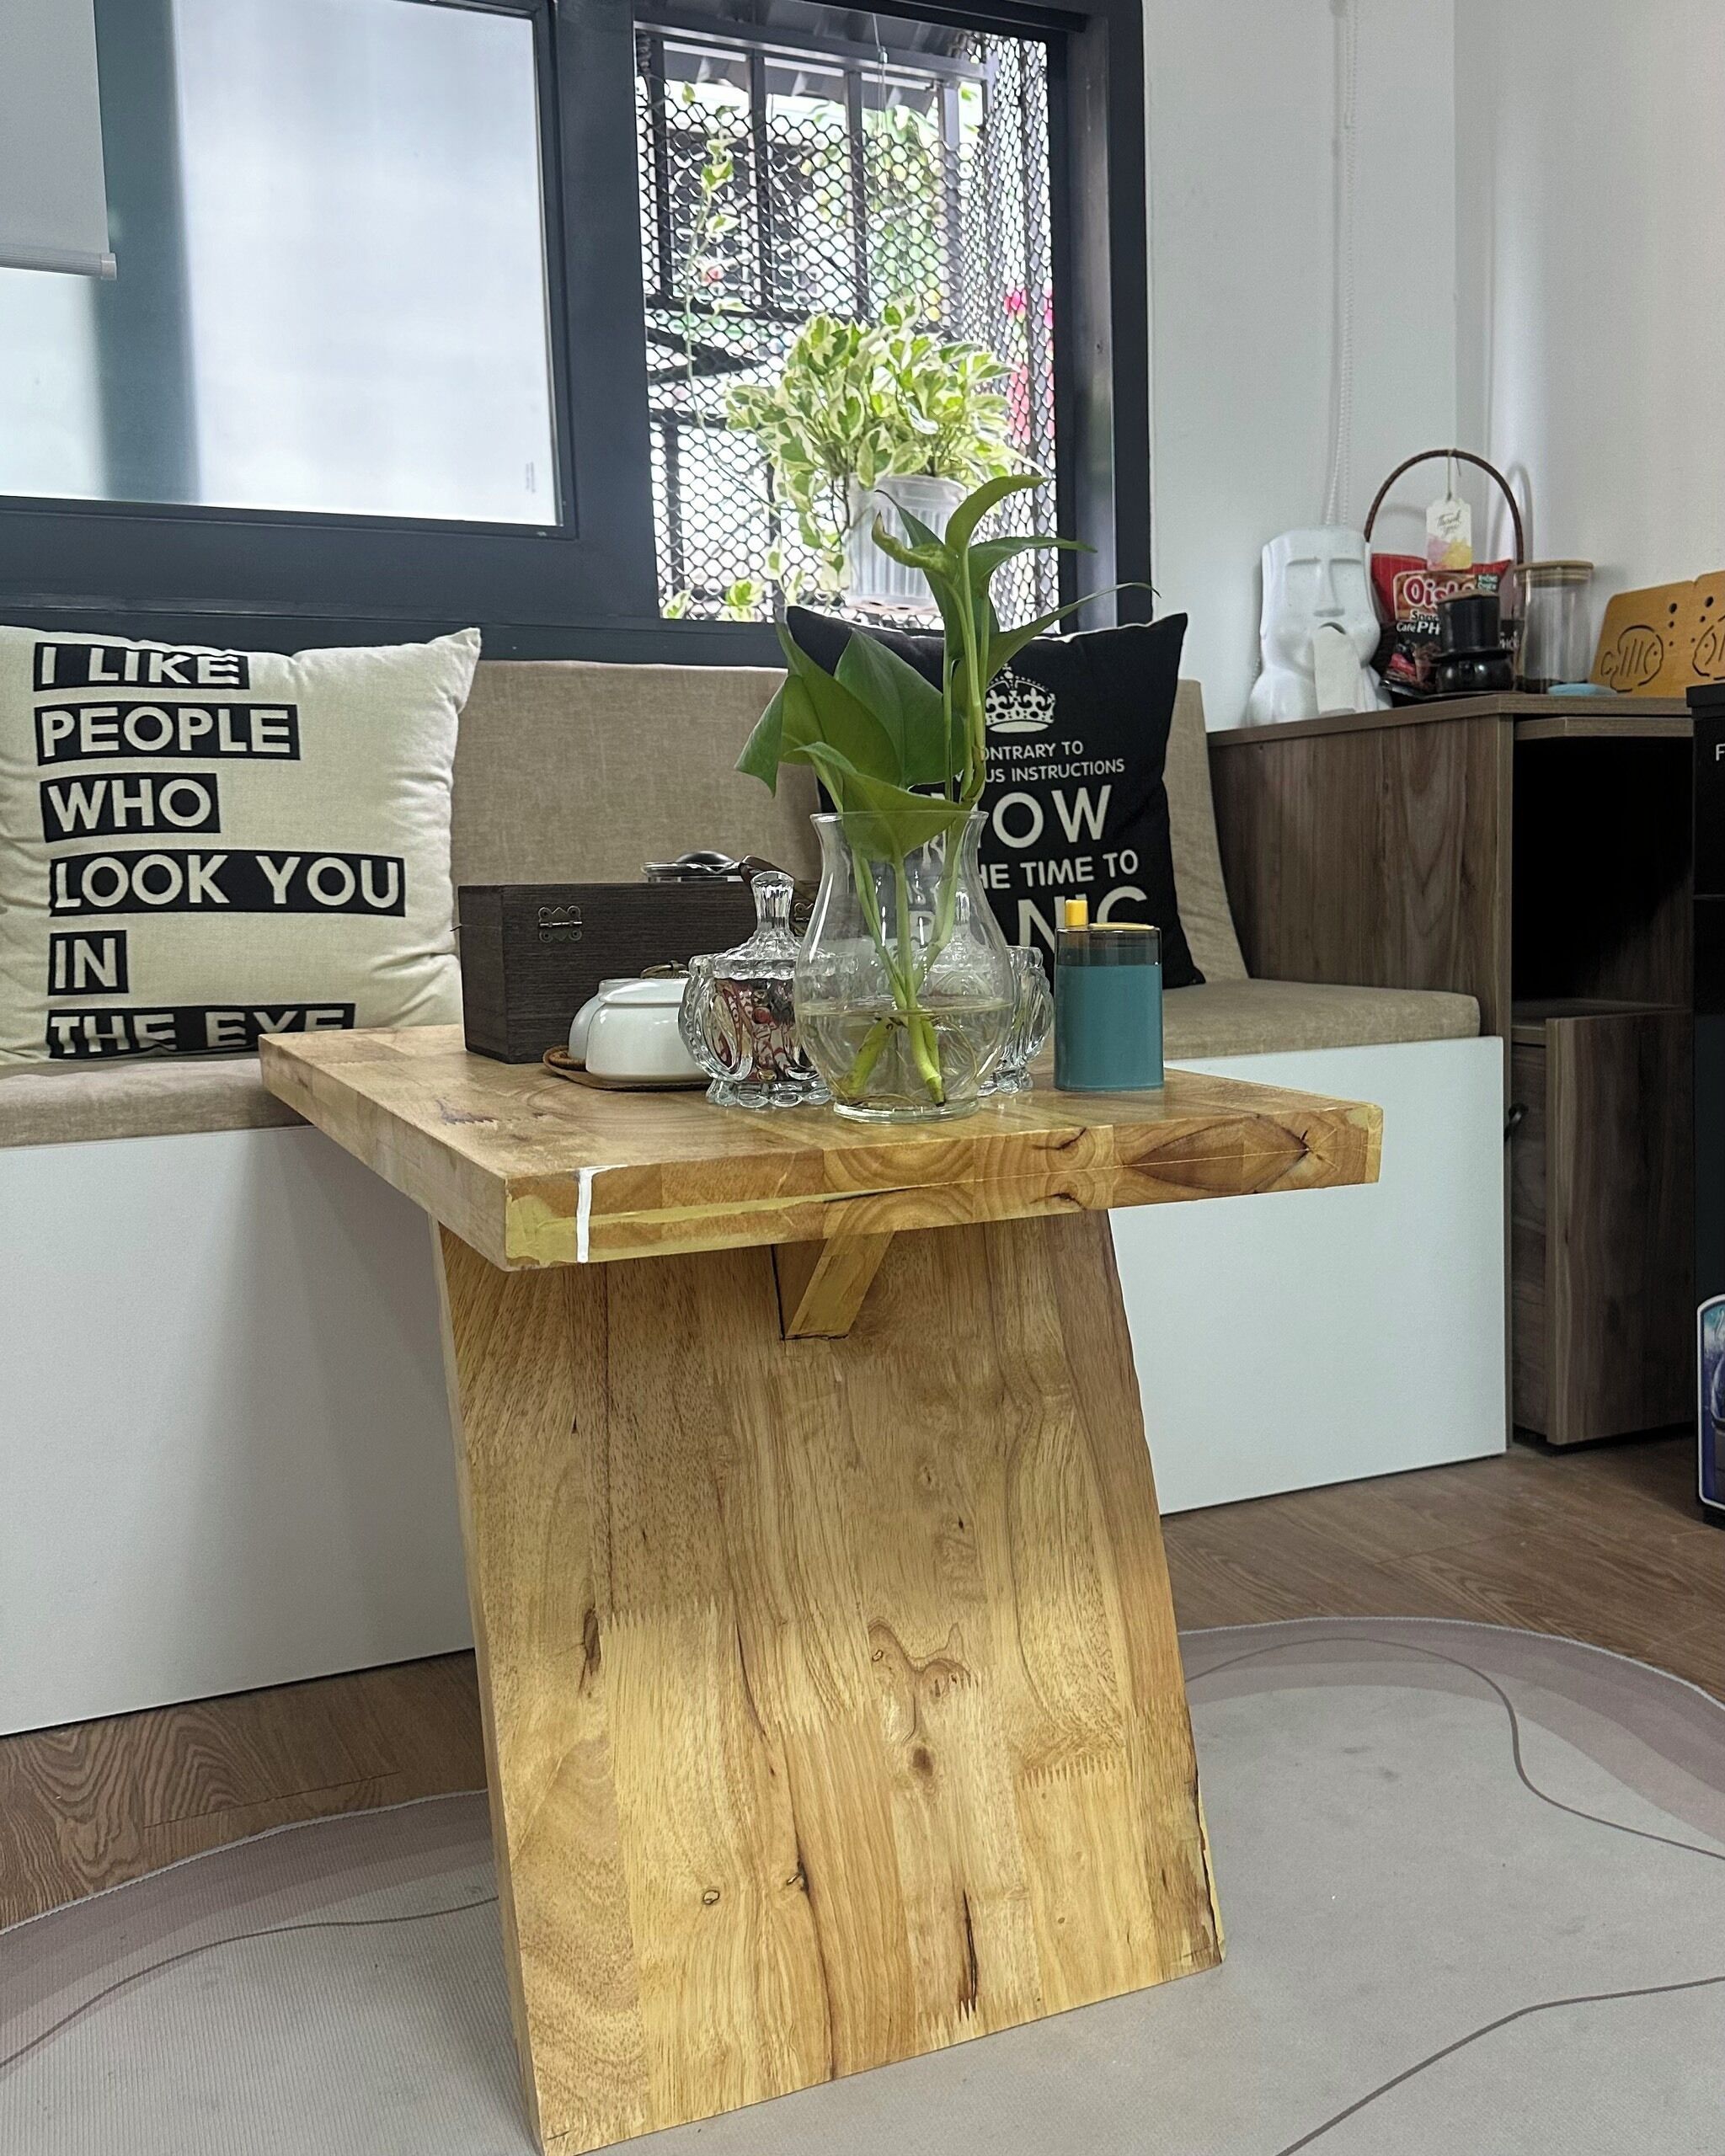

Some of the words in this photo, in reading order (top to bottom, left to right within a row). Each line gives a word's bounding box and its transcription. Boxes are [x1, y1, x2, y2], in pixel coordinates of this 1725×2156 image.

[1417, 621, 1440, 635] PH
[41, 647, 56, 684] I
[87, 648, 241, 684] LIKE
[40, 706, 292, 757] PEOPLE
[1061, 740, 1084, 755] TO
[1011, 758, 1125, 782] INSTRUCTIONS
[47, 778, 212, 832] WHO
[975, 784, 1112, 849] OW
[55, 854, 229, 908] LOOK
[255, 856, 399, 908] YOU
[1020, 857, 1093, 887] TIME
[1102, 850, 1138, 878] TO
[55, 937, 118, 989] IN
[51, 1013, 176, 1054] THE
